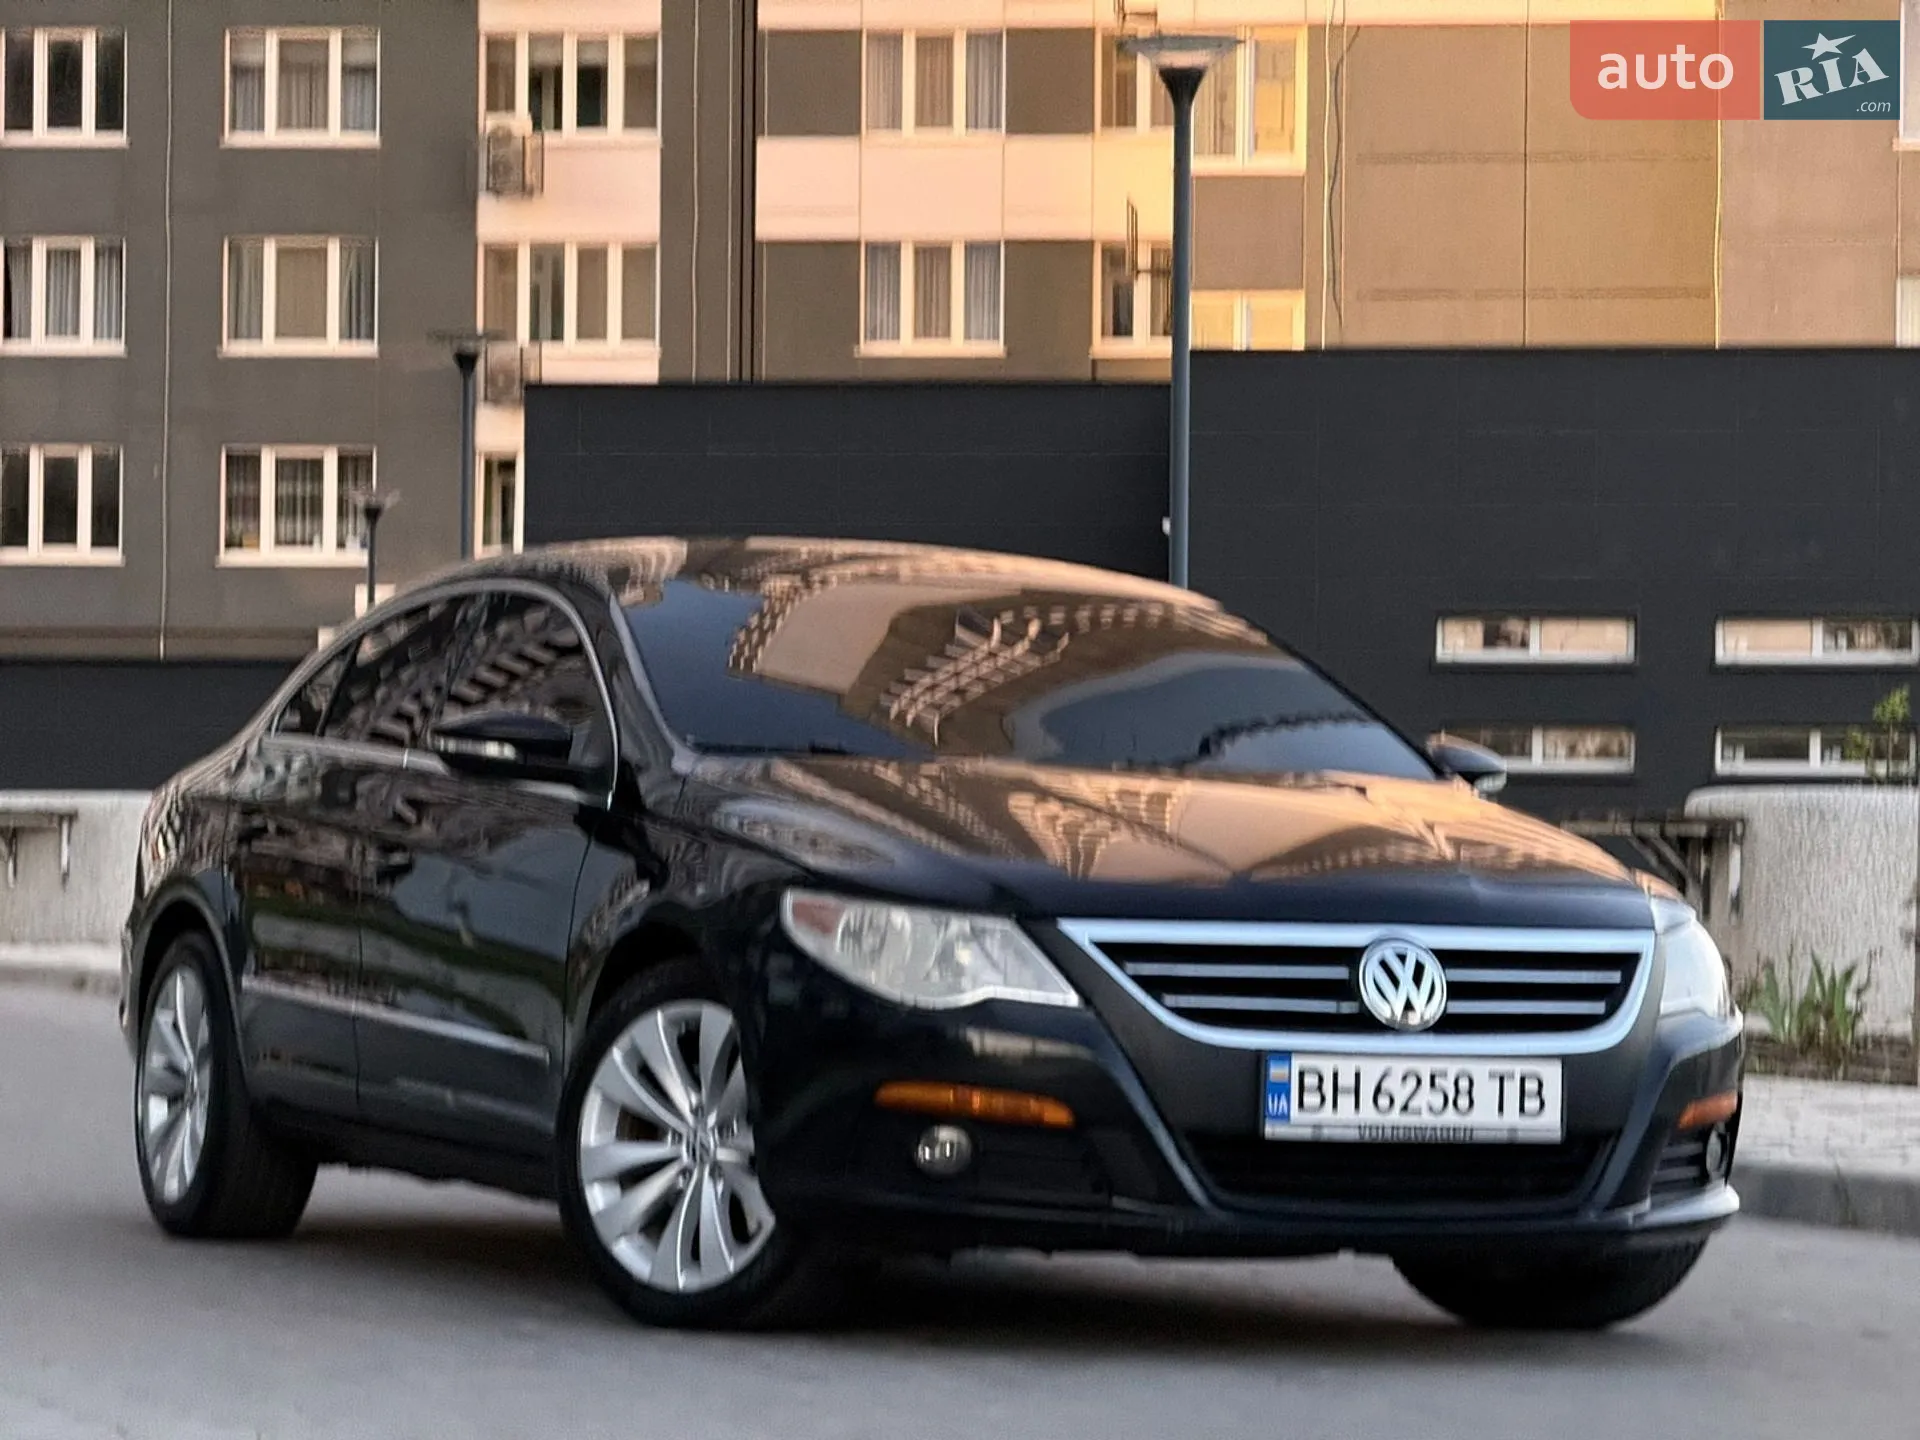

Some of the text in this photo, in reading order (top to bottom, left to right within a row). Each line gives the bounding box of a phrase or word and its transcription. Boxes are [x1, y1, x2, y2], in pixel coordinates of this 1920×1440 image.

[1362, 940, 1445, 1030] VW
[1267, 1091, 1289, 1117] UA
[1297, 1066, 1546, 1118] BH 6258 TB
